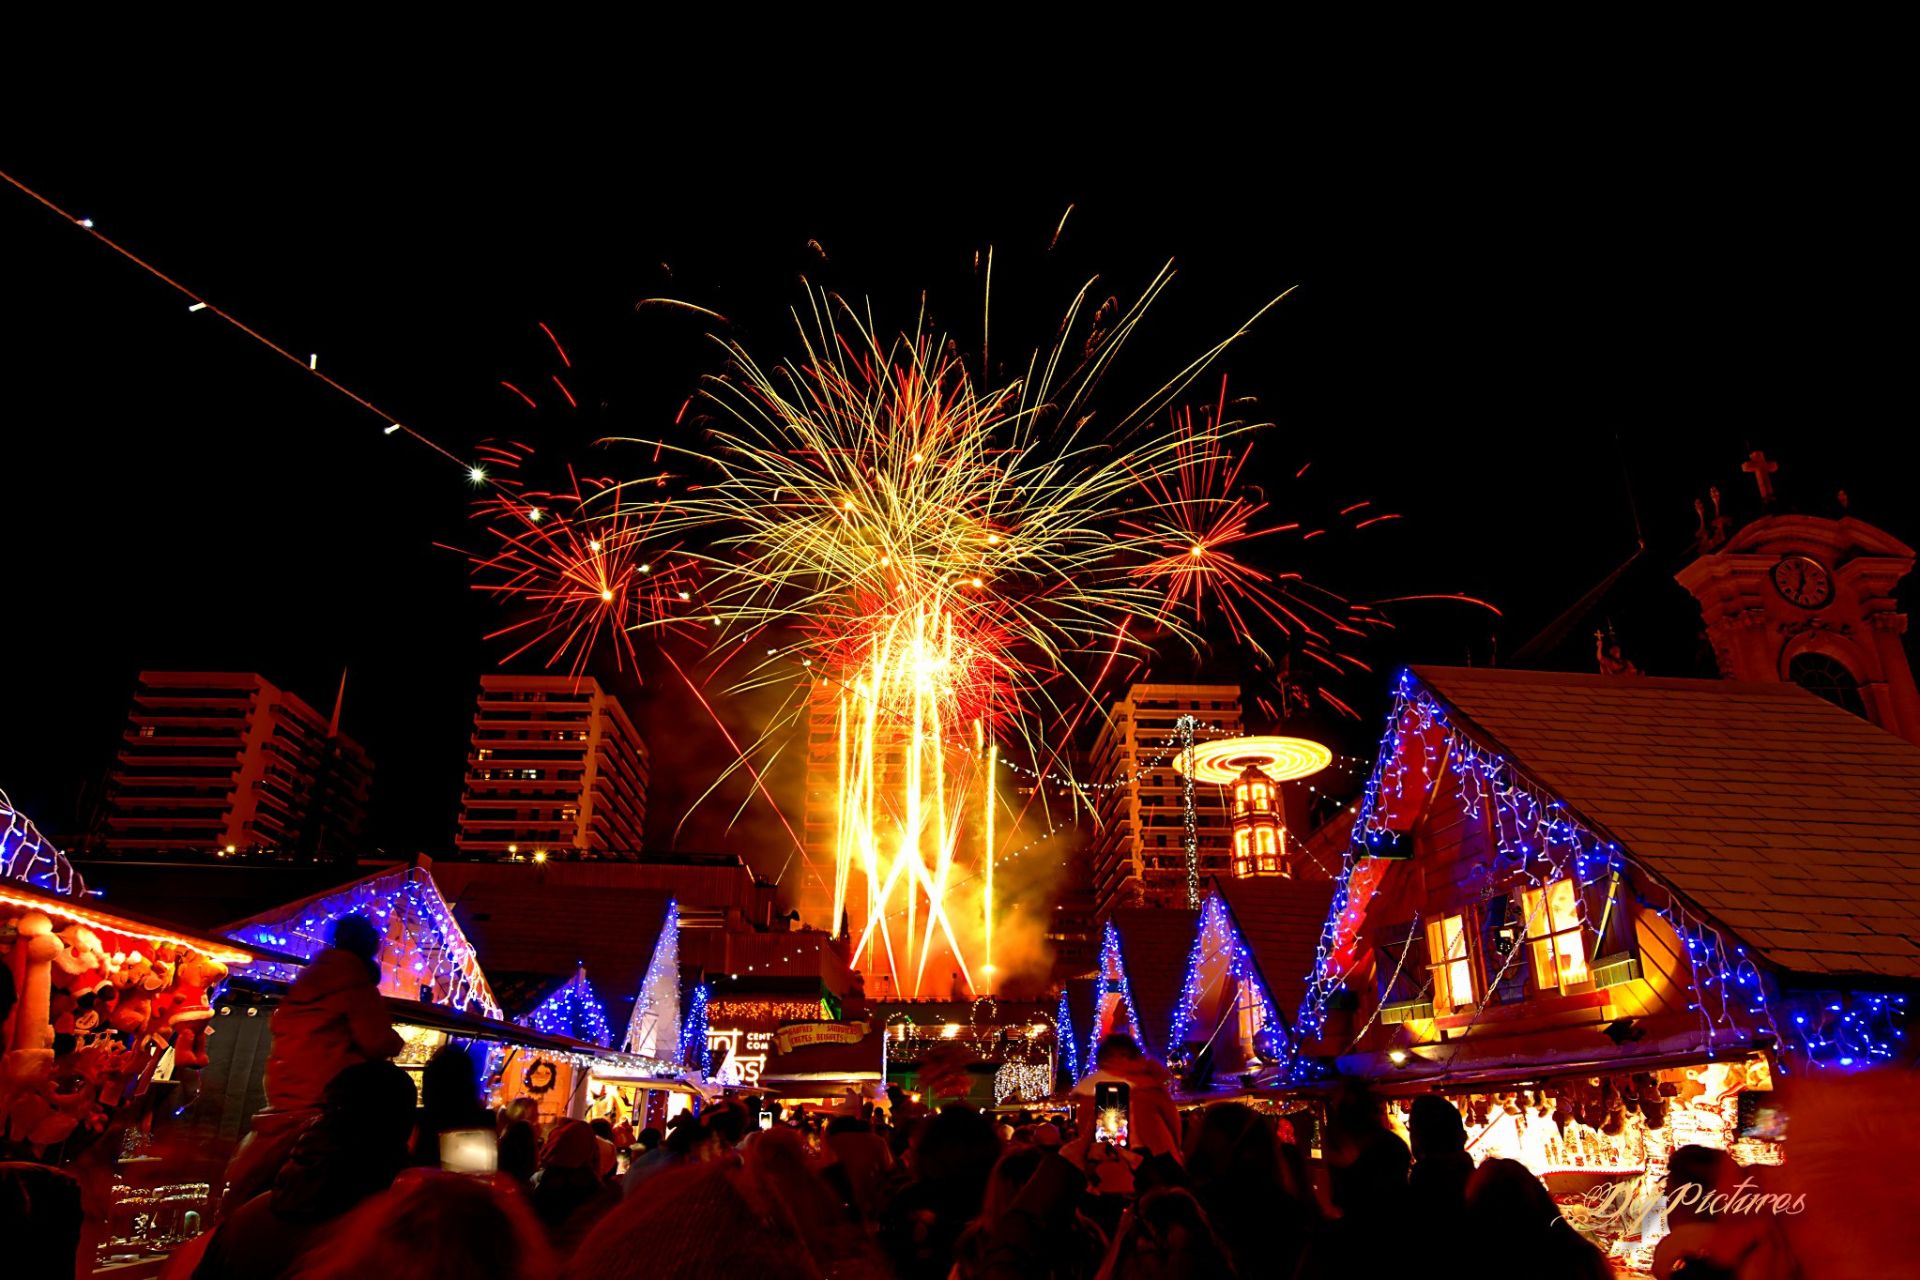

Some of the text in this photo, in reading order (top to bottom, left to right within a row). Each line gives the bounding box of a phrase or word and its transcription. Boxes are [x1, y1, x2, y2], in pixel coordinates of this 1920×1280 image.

[746, 1032, 774, 1041] CENT
[816, 1033, 844, 1042] BEIGNETS
[746, 1041, 769, 1050] COM
